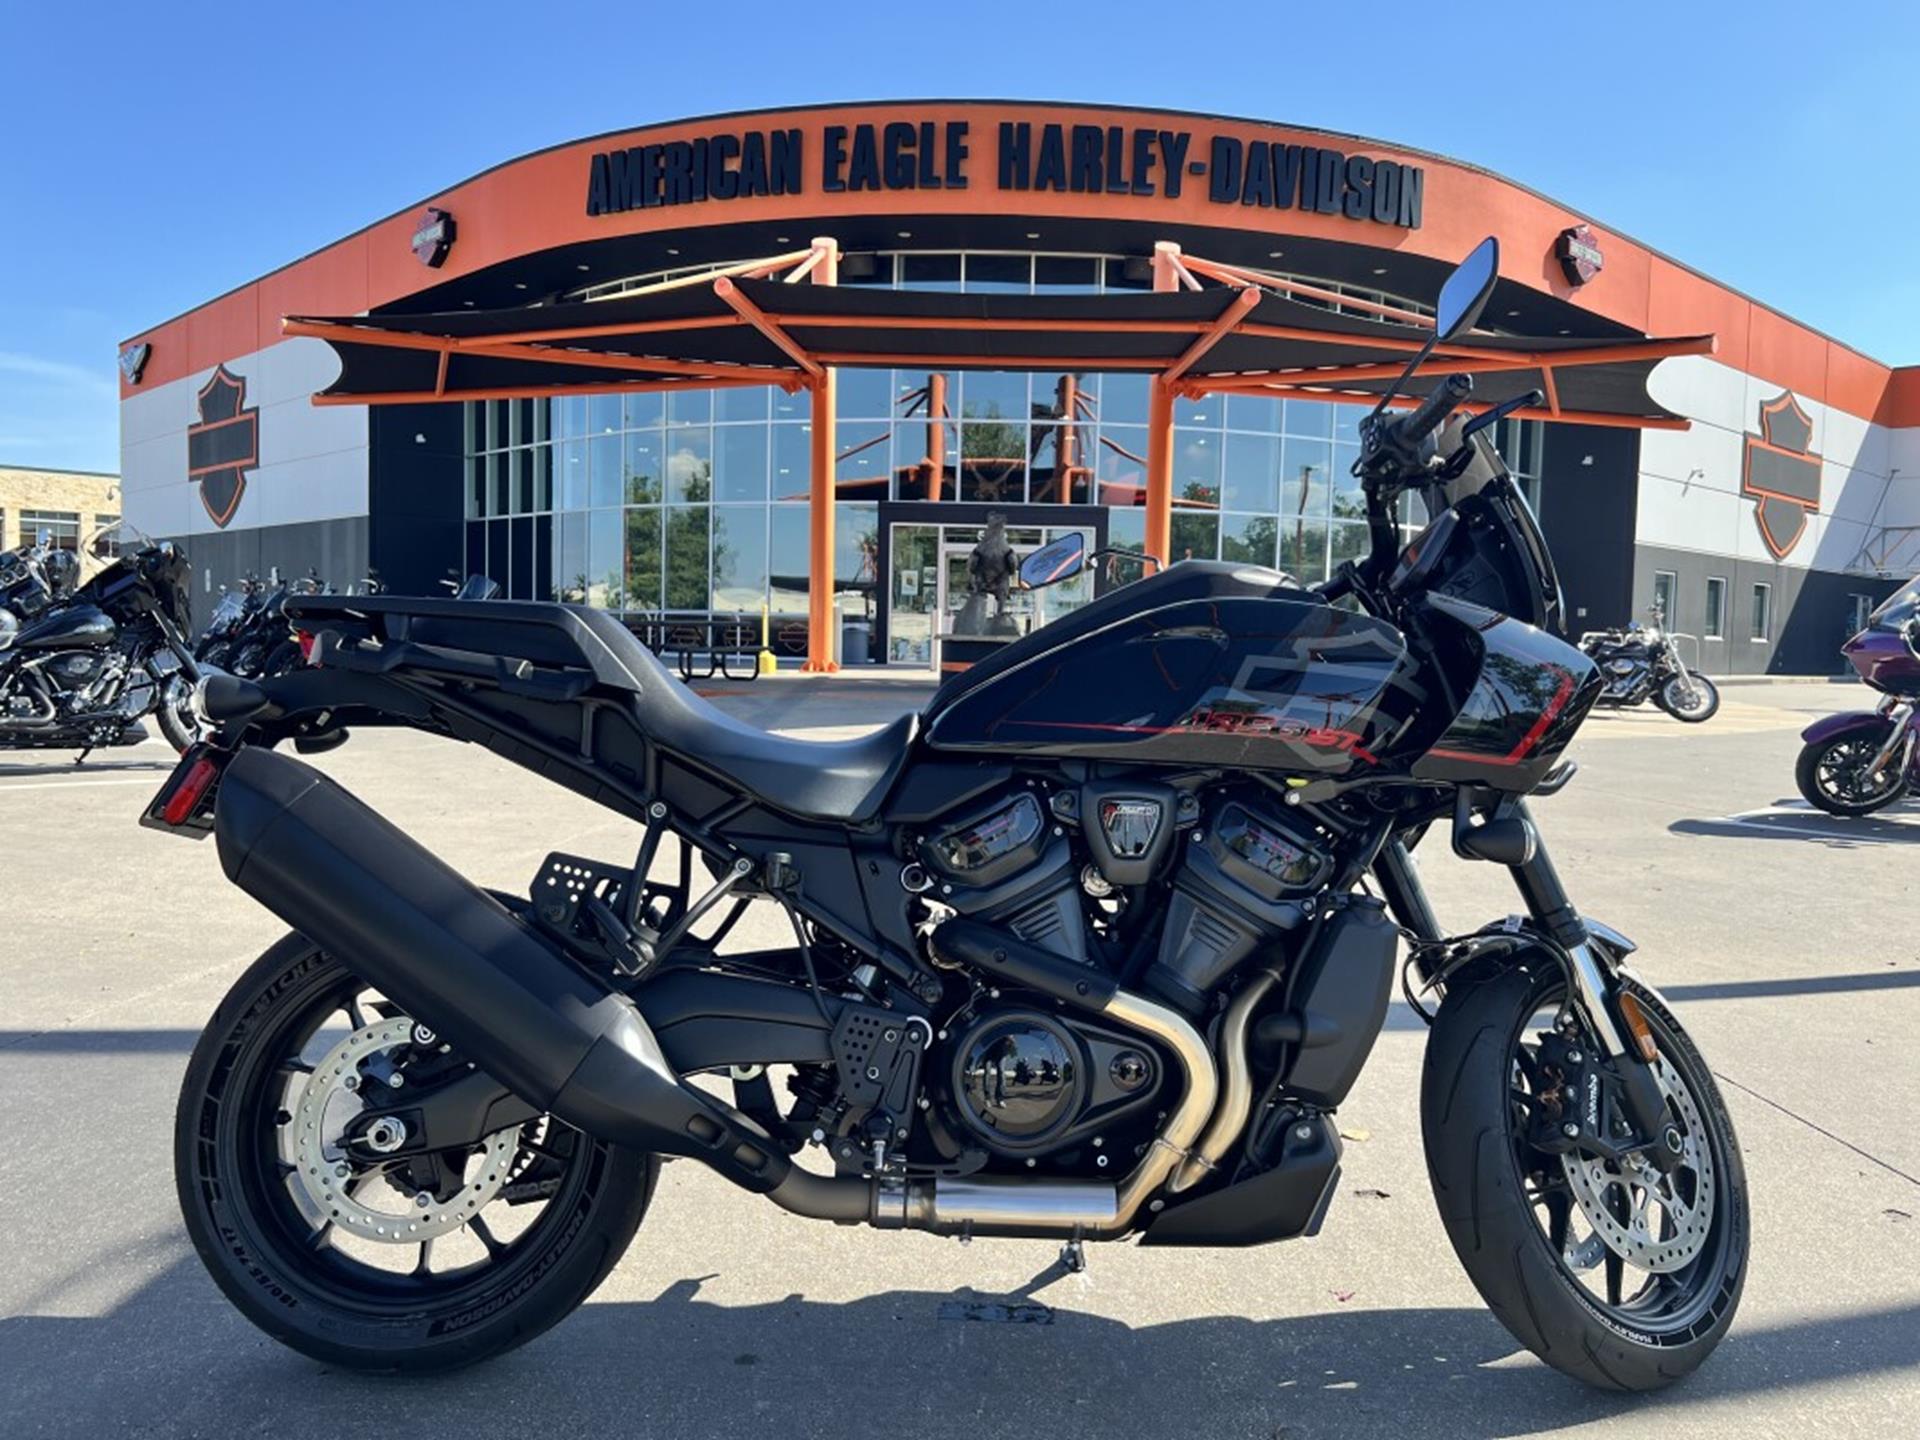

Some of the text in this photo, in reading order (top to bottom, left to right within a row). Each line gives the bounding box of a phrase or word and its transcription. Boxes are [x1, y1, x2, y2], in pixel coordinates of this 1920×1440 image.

[586, 121, 1424, 230] AMERICAN EAGLE HARLEY-DAVIDSON
[250, 949, 334, 1016] MICHEL
